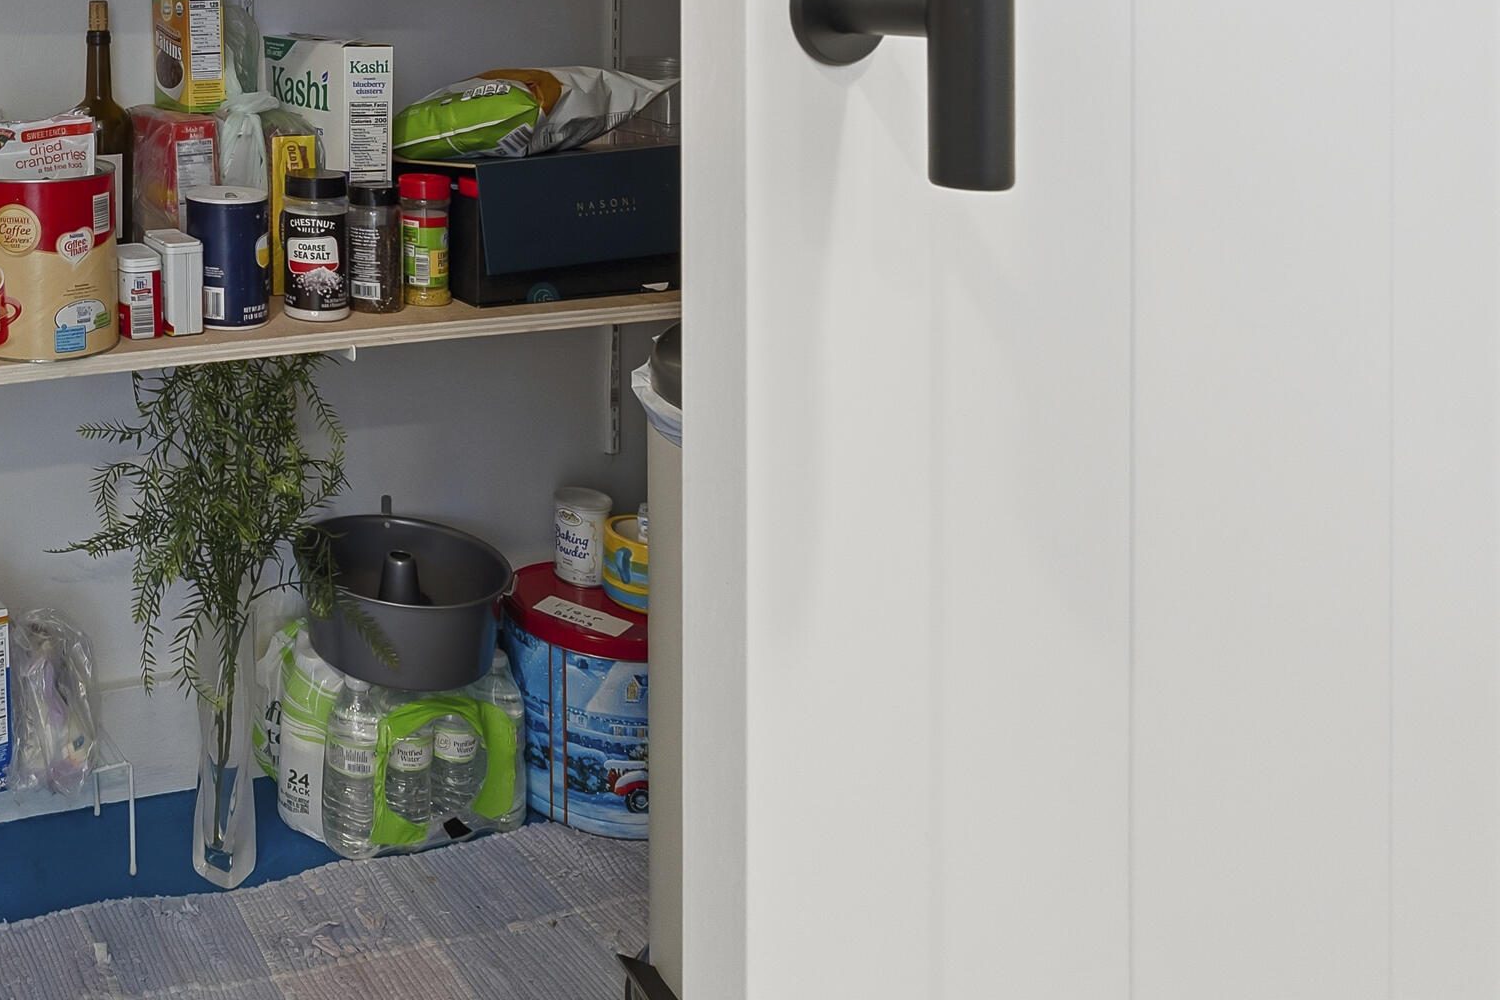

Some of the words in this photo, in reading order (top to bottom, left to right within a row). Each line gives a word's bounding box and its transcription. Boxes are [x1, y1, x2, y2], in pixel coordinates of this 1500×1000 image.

[349, 60, 389, 74] Kashi
[271, 65, 330, 112] Kashi
[352, 81, 387, 89] blueberry
[26, 128, 67, 141] SWEETENED
[29, 140, 62, 156] dried
[15, 150, 87, 170] cranberries
[298, 243, 326, 252] COARSE
[293, 250, 310, 259] SEA
[310, 251, 331, 260] SALT
[555, 541, 589, 560] Powder
[397, 748, 422, 756] Purified
[287, 768, 310, 789] 24
[287, 782, 310, 796] PACK
